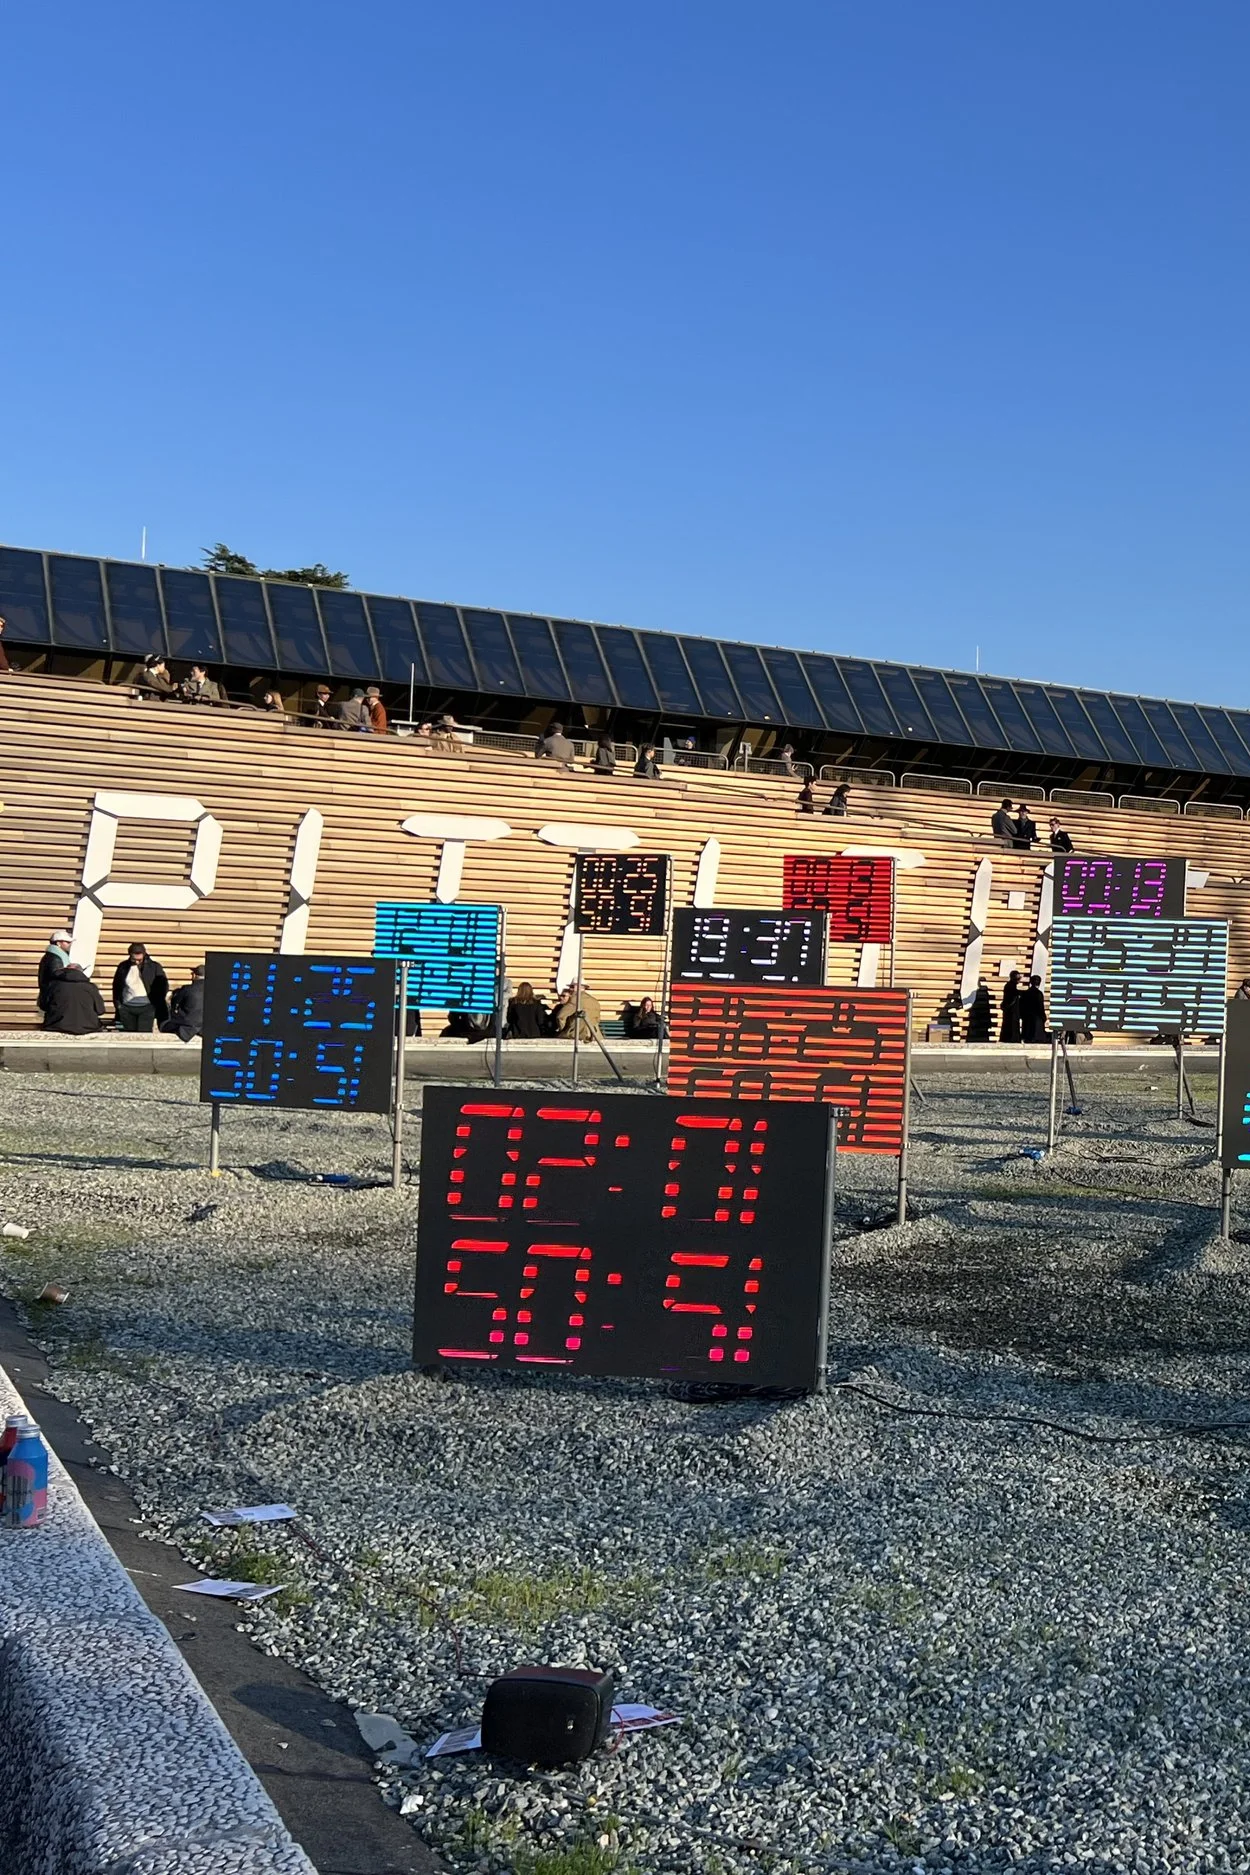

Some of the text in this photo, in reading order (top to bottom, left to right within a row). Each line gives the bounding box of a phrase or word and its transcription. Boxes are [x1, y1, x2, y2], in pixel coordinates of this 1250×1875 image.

[580, 857, 659, 894] 00:25
[1061, 860, 1167, 903] 07:13
[578, 895, 653, 932] 50:51
[690, 914, 812, 966] 19:37
[226, 961, 376, 1031] 14:25
[208, 1035, 364, 1105] 50:51
[446, 1103, 769, 1225] 02:01
[436, 1239, 764, 1366] 50:51
